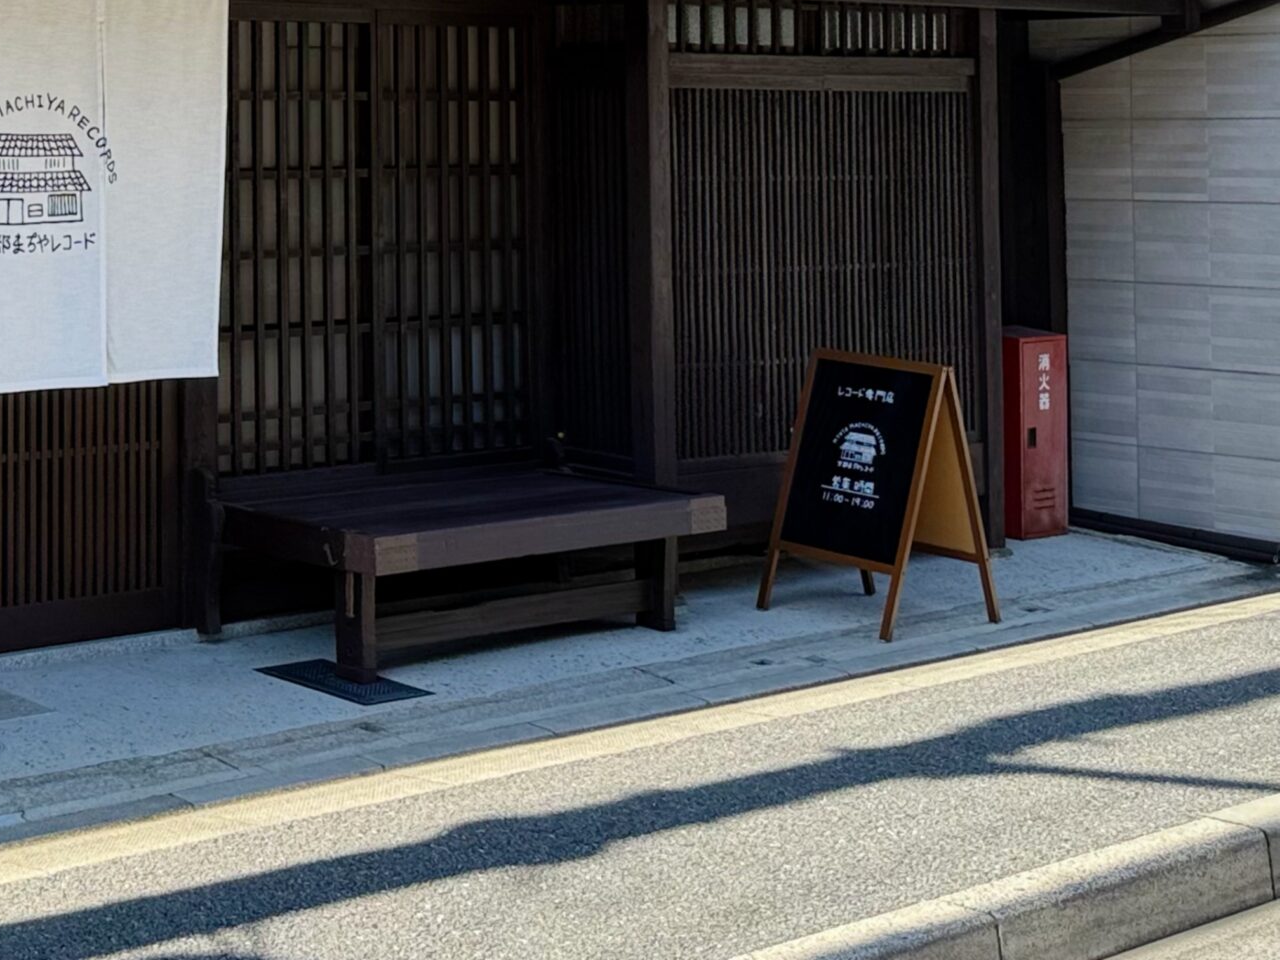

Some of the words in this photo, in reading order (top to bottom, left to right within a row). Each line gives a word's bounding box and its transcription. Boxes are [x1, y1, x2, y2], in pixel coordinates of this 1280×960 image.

[67, 105, 118, 184] RECORDS
[1038, 353, 1050, 410] 消火器
